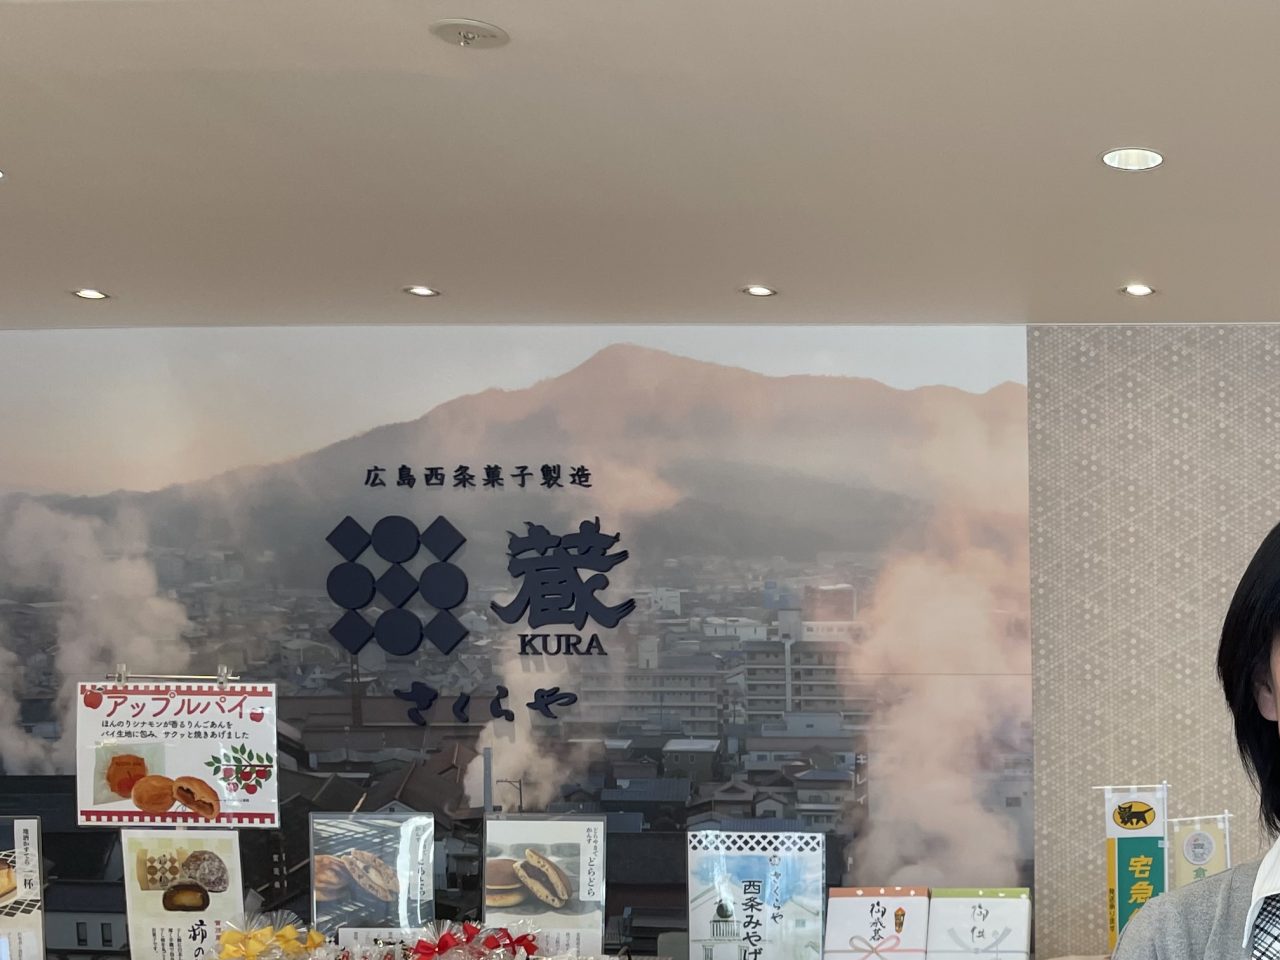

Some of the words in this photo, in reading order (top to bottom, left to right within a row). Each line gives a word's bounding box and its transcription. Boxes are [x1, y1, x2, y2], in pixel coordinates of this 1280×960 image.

[364, 464, 593, 488] 広島西条菓子製造
[490, 516, 636, 631] 蔵
[518, 633, 607, 656] KURA
[106, 691, 248, 719] アップルパイ
[393, 681, 578, 726] さくらや
[101, 719, 233, 729] ほんのりシナモンが香るりんごあんを
[101, 729, 249, 739] パイ生地に包み、サクッと焼きあげました
[586, 857, 596, 897] どらどら
[1129, 855, 1155, 918] 宅急
